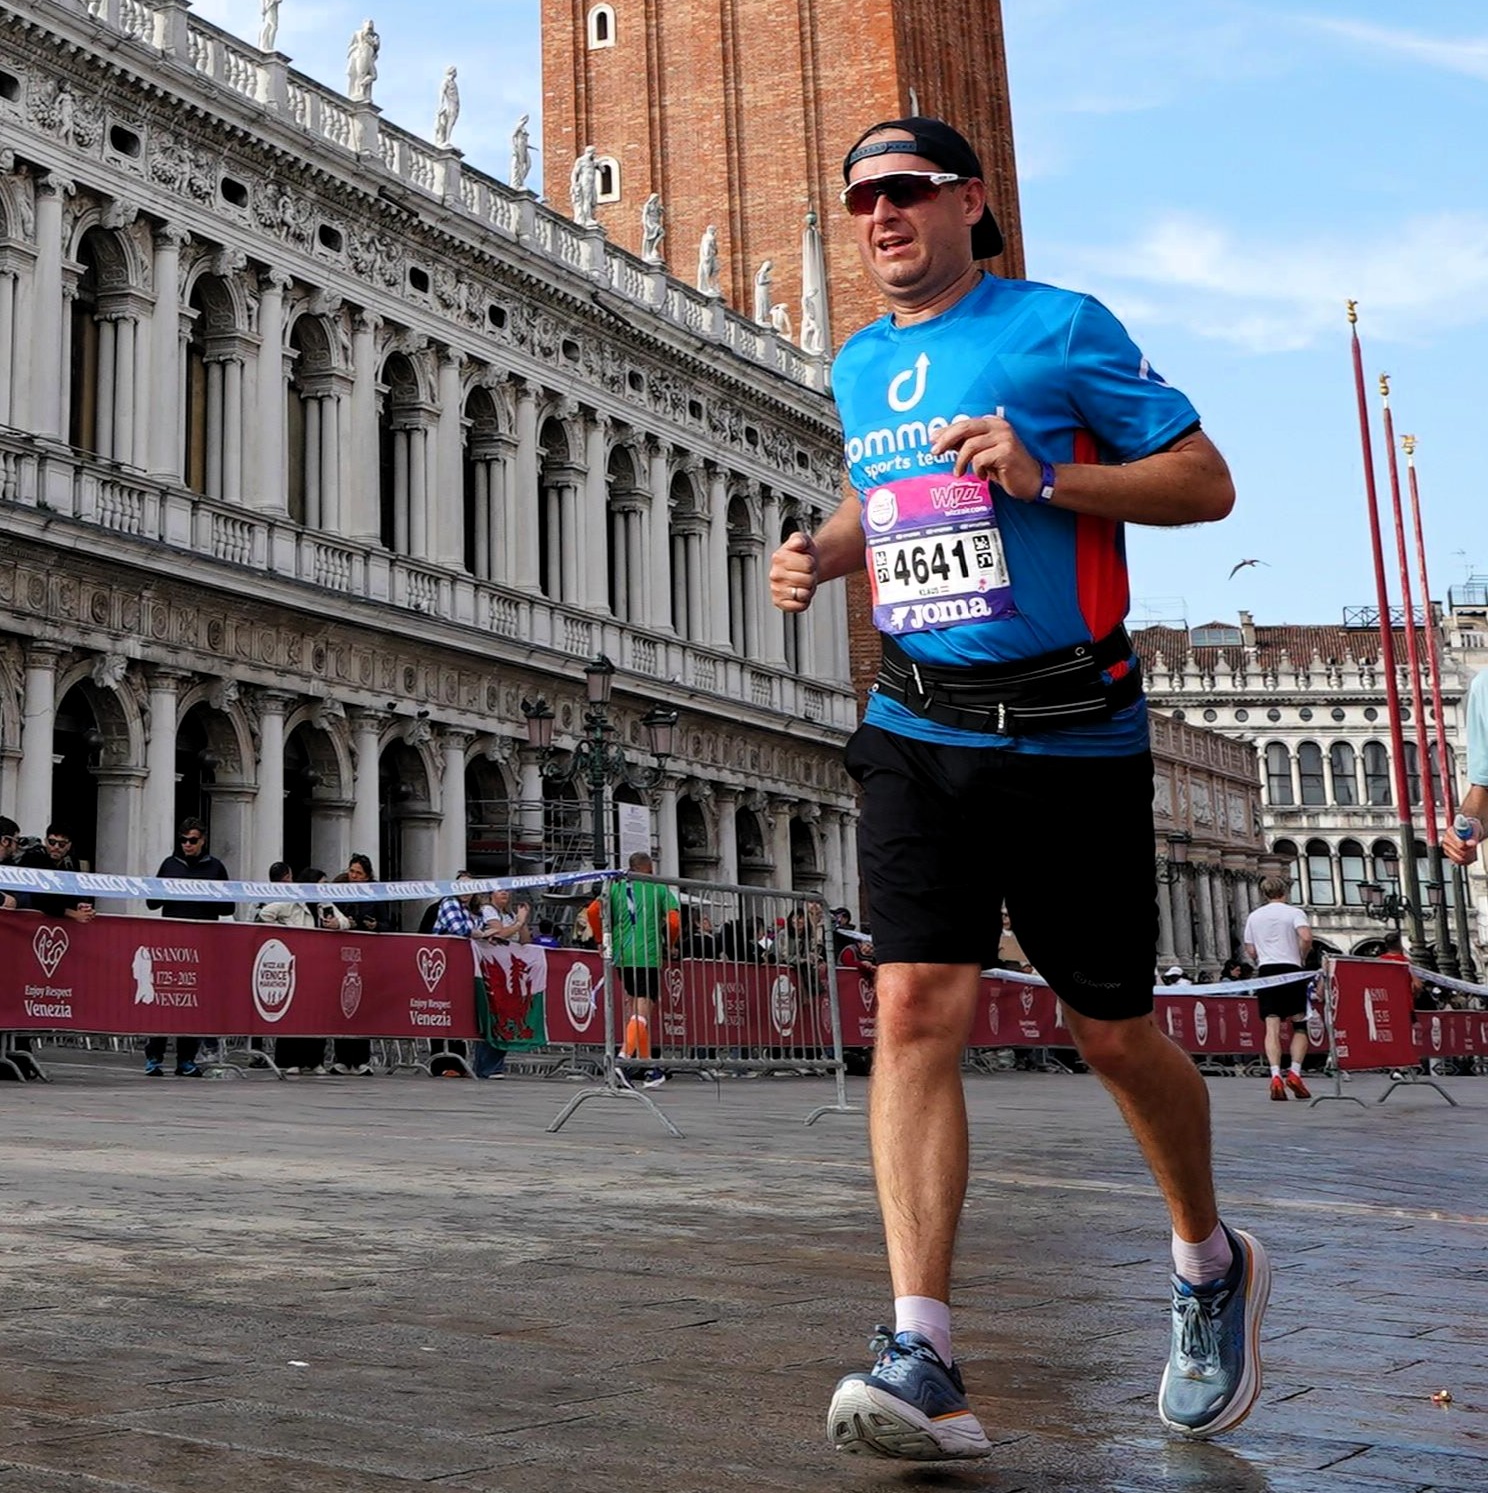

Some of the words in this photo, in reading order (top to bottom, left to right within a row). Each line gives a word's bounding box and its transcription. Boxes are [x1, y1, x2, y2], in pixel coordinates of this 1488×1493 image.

[864, 455, 911, 479] sports
[893, 539, 969, 587] 4641
[140, 946, 200, 963] CASANOVA
[260, 970, 287, 981] VENICE
[25, 984, 45, 999] Enjoy
[45, 985, 73, 1000] Respect
[154, 992, 199, 1008] VENEZIA
[24, 999, 73, 1018] Venezia
[409, 1010, 452, 1026] Venezia
